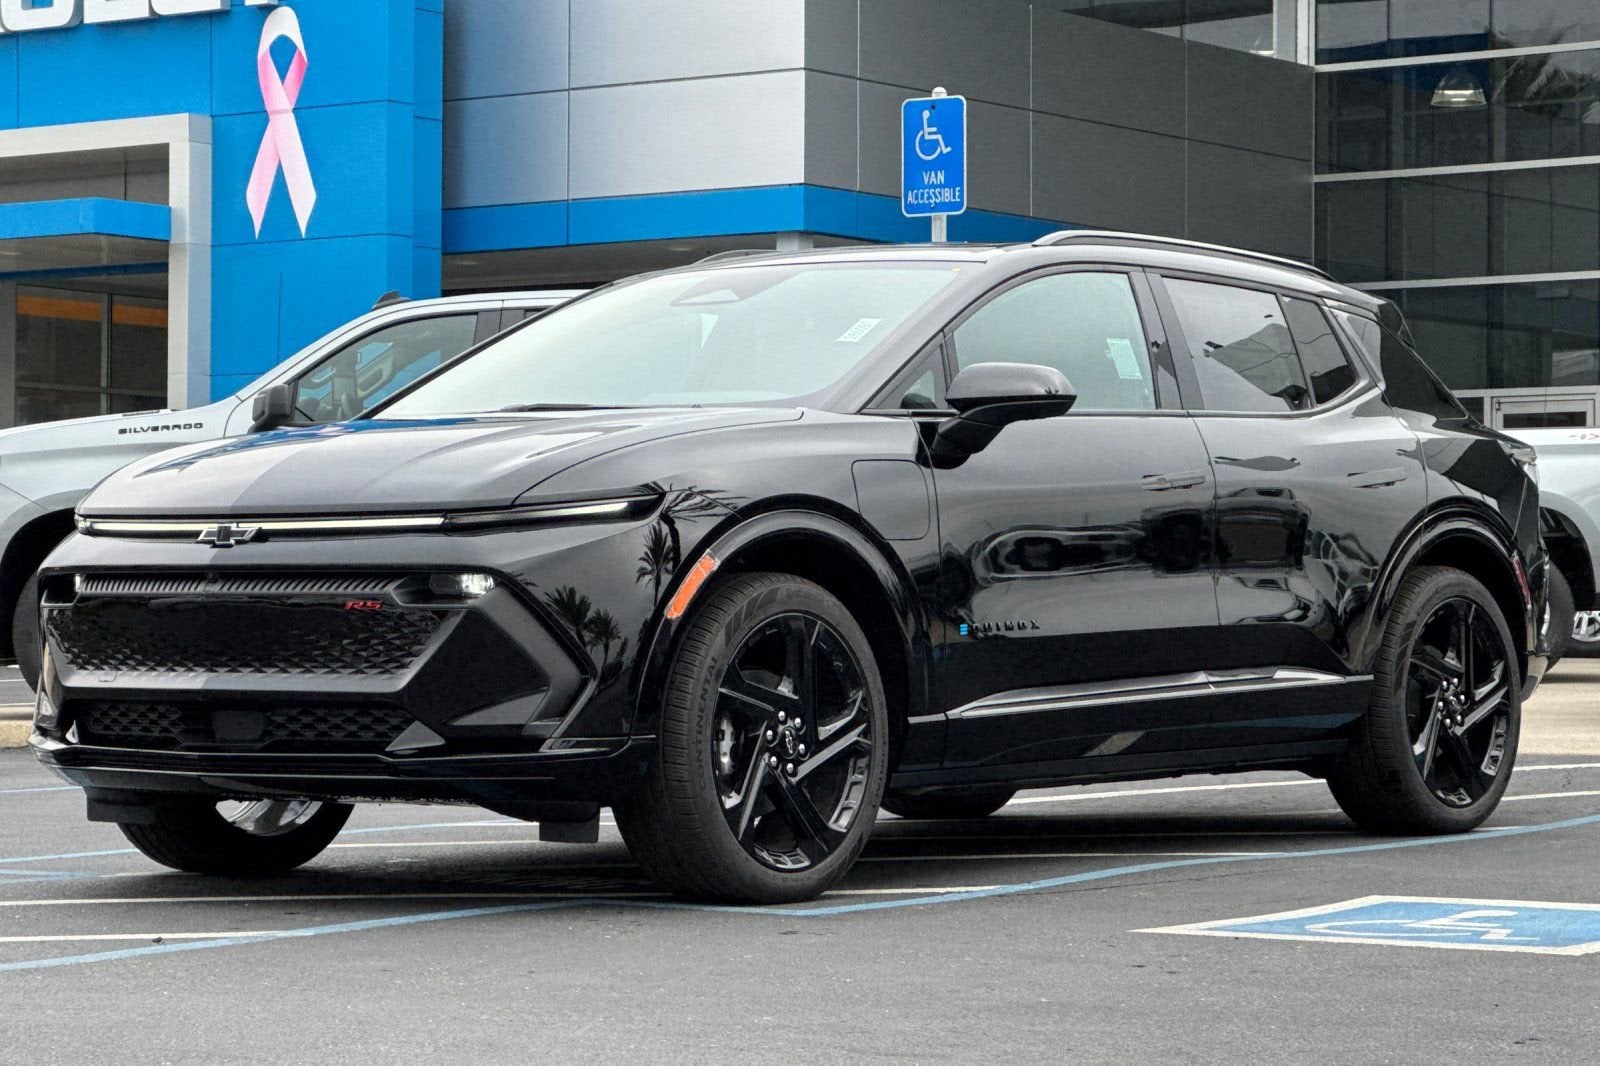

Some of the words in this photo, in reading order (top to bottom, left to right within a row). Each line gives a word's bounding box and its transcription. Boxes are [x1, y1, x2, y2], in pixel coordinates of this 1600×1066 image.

[922, 170, 945, 185] VAN
[907, 187, 961, 205] ACCESSIBLE
[118, 422, 204, 435] SILVERADO
[343, 600, 382, 610] RS
